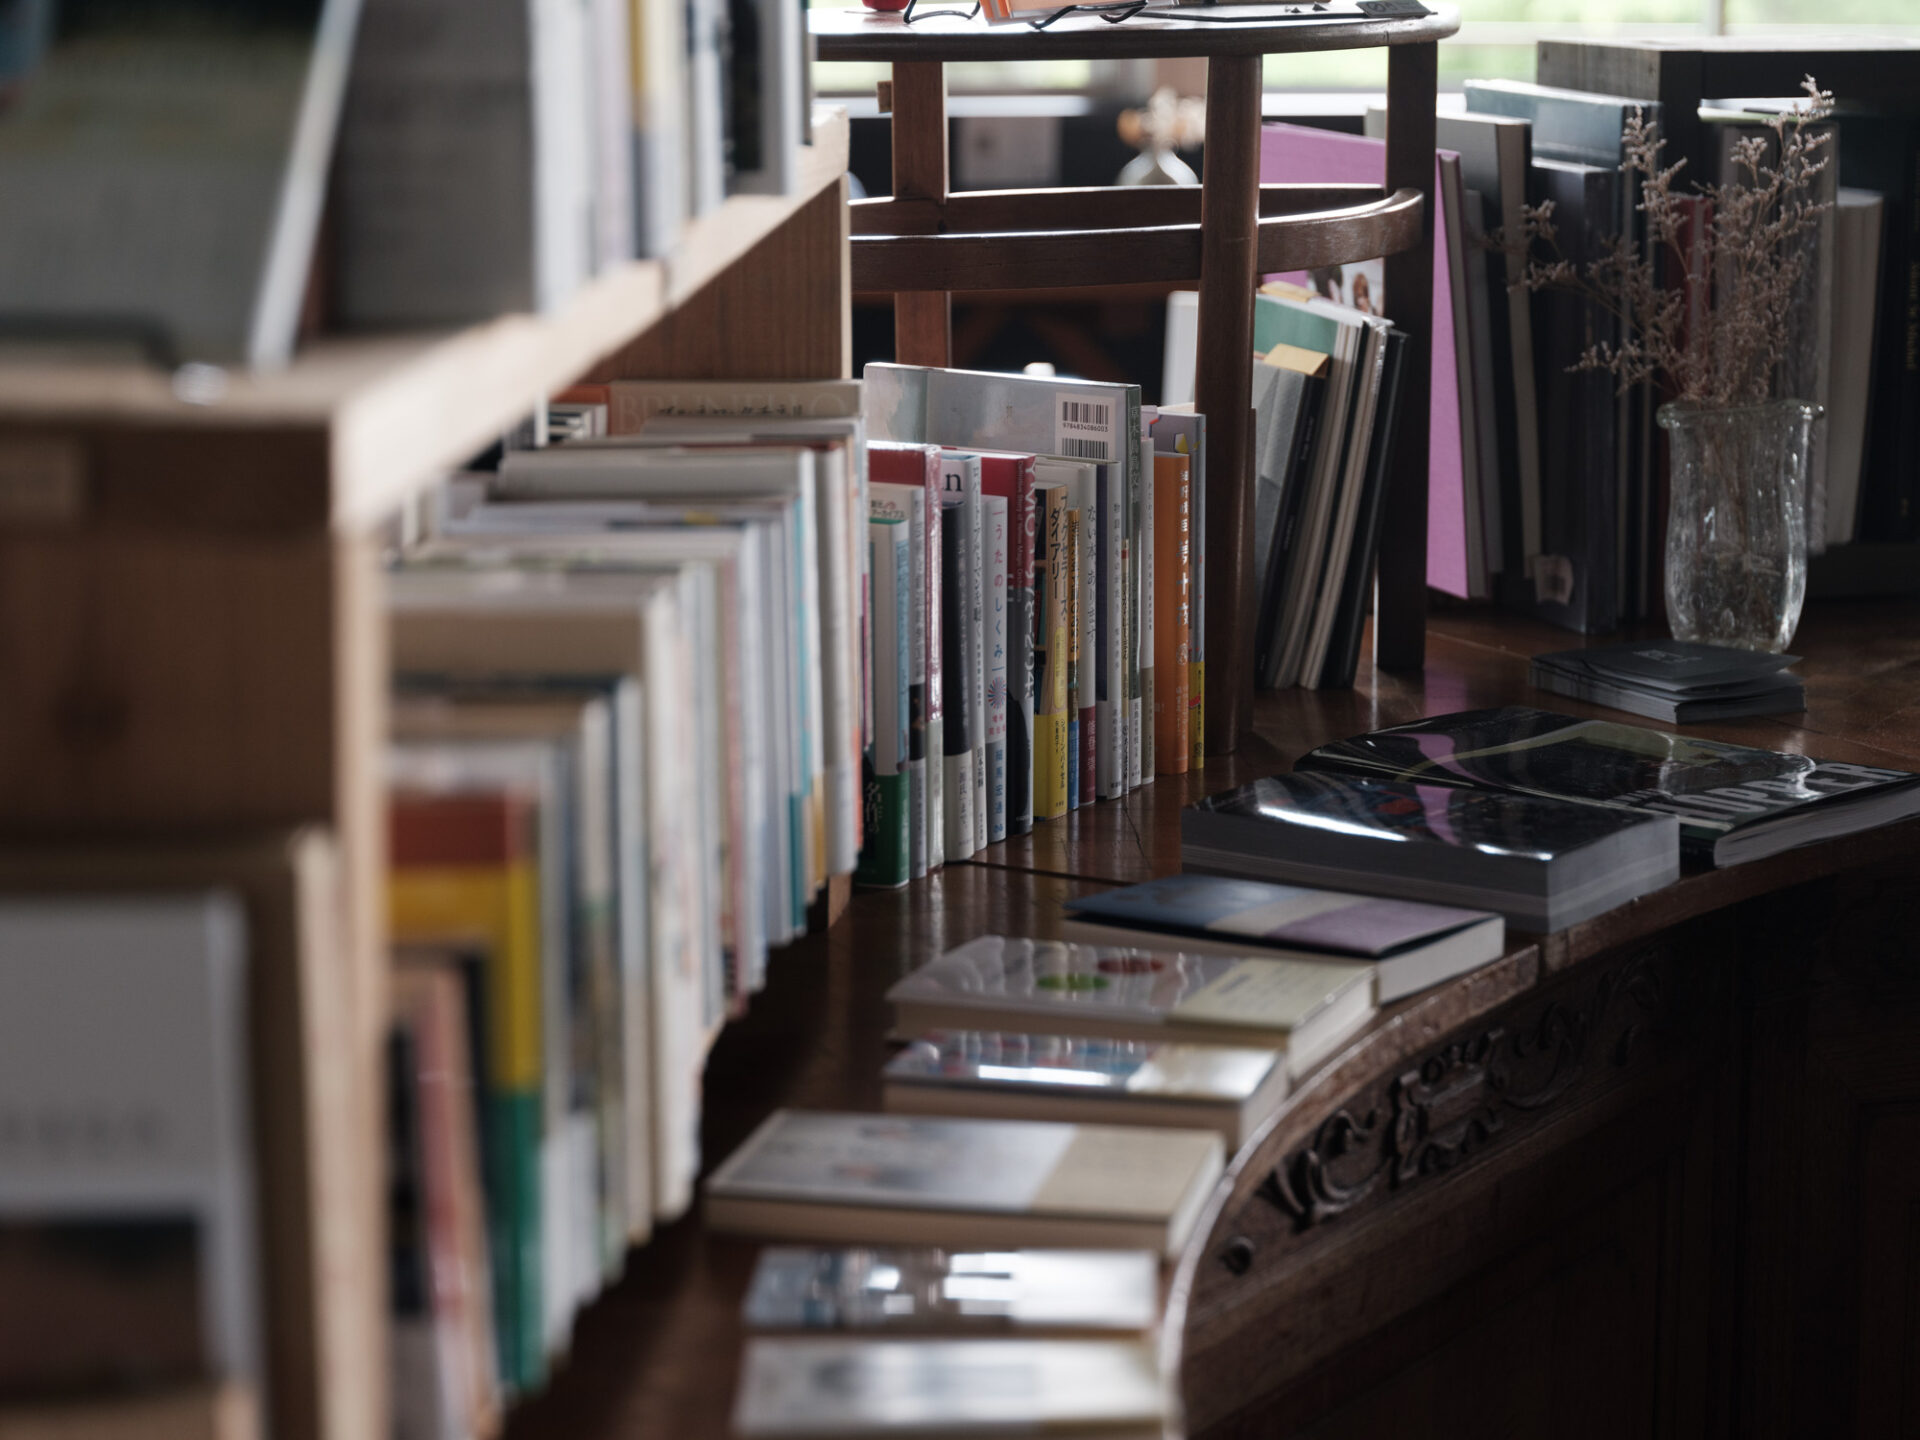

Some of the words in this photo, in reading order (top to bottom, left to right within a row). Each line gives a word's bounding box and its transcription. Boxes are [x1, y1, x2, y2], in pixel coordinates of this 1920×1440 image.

[1050, 507, 1061, 600] ダイアリー
